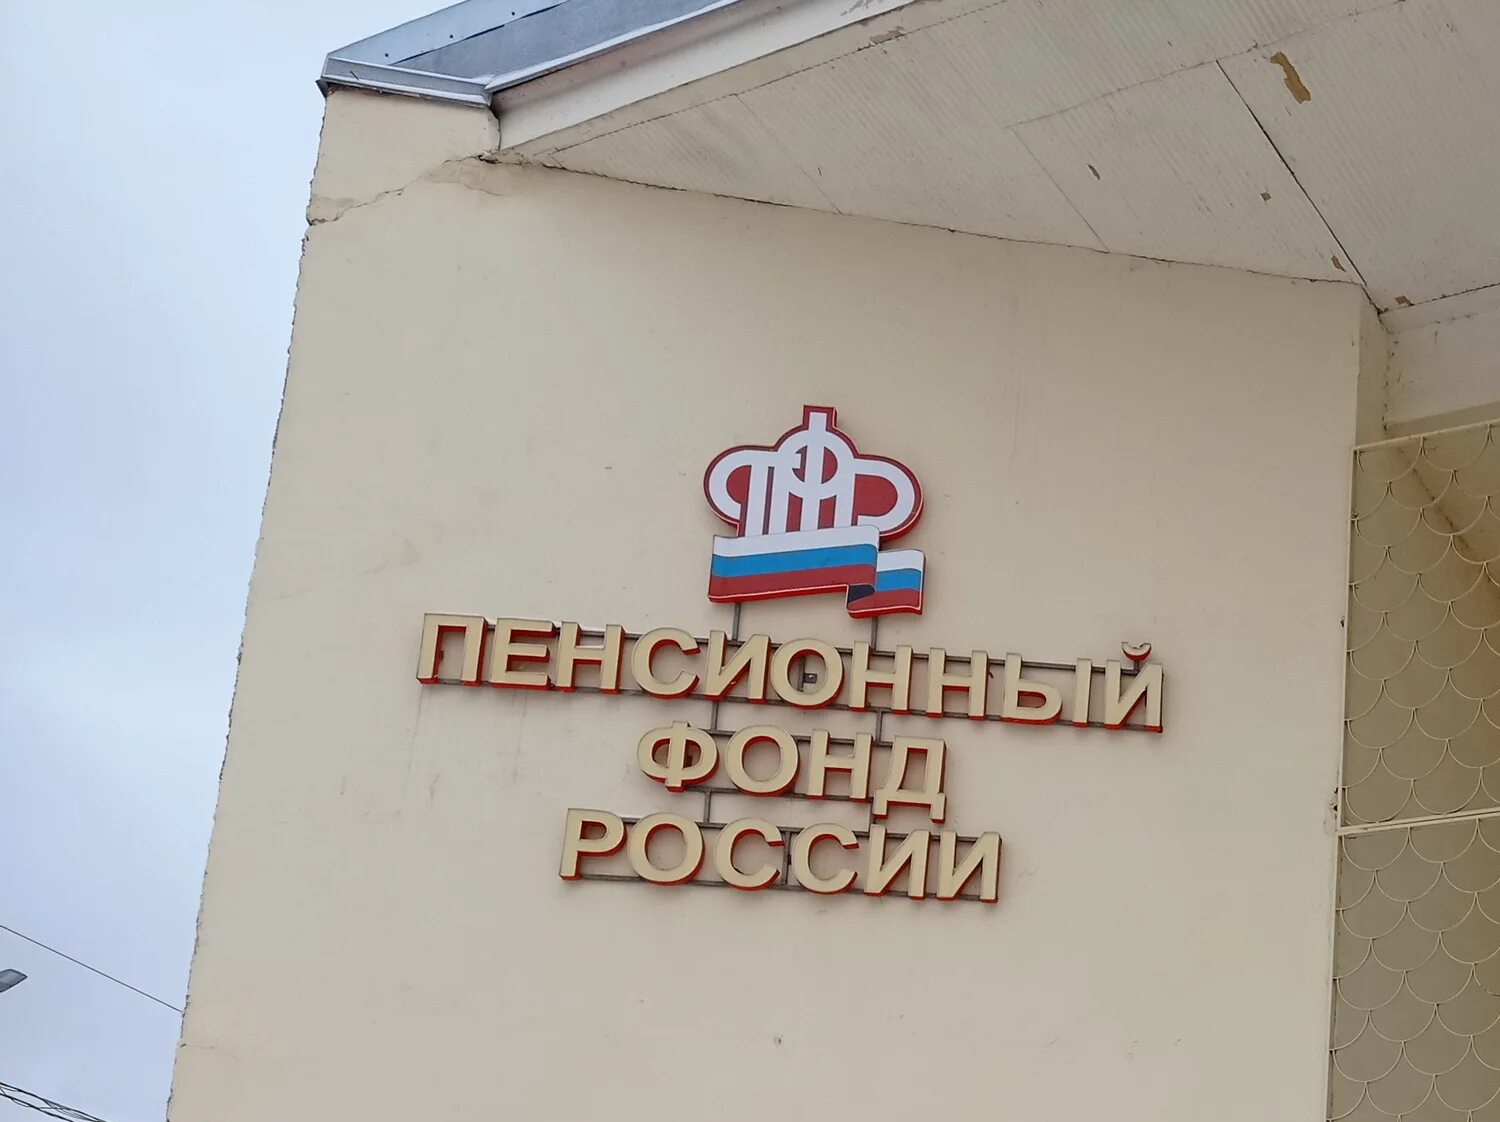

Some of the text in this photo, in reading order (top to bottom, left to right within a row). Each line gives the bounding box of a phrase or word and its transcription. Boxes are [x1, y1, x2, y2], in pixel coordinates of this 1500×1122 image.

[417, 613, 1163, 733] ПЕНСИОННЫЙ
[636, 721, 947, 823] ФОНД
[559, 808, 1002, 902] РОССИИ
